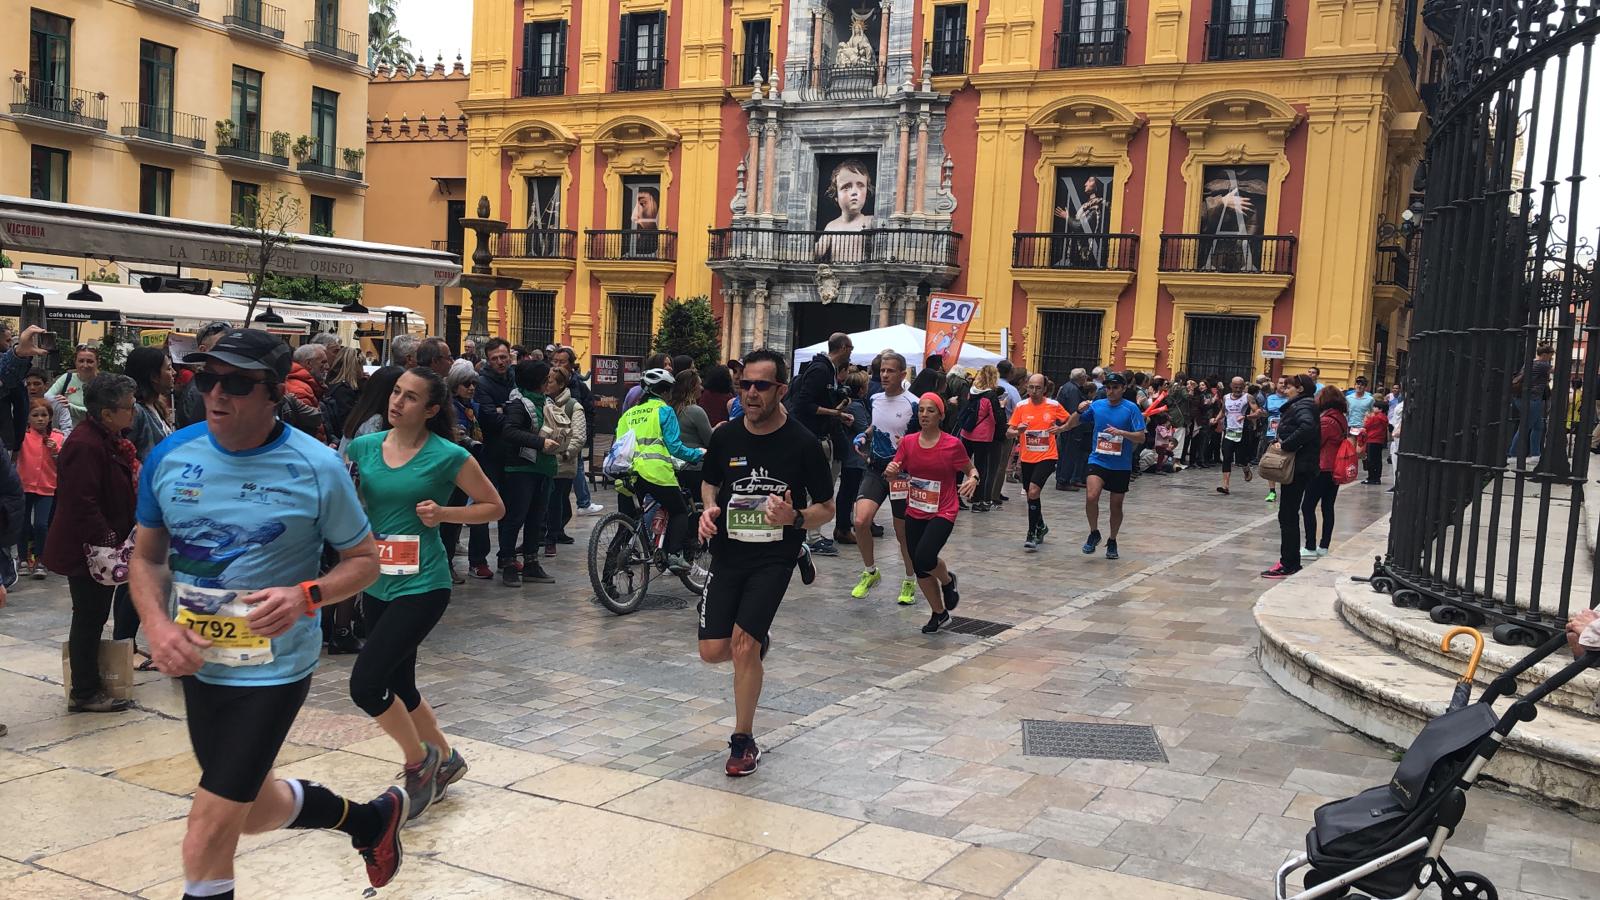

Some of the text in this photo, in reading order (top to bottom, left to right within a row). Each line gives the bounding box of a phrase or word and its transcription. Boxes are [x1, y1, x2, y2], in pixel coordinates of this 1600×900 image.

[7, 222, 45, 237] VICTORIA
[169, 245, 355, 275] LA TABERNA DEL OBISPO
[434, 270, 455, 279] VICTORIA
[64, 311, 91, 319] restobar
[940, 302, 971, 321] 20
[733, 513, 762, 524] 1341
